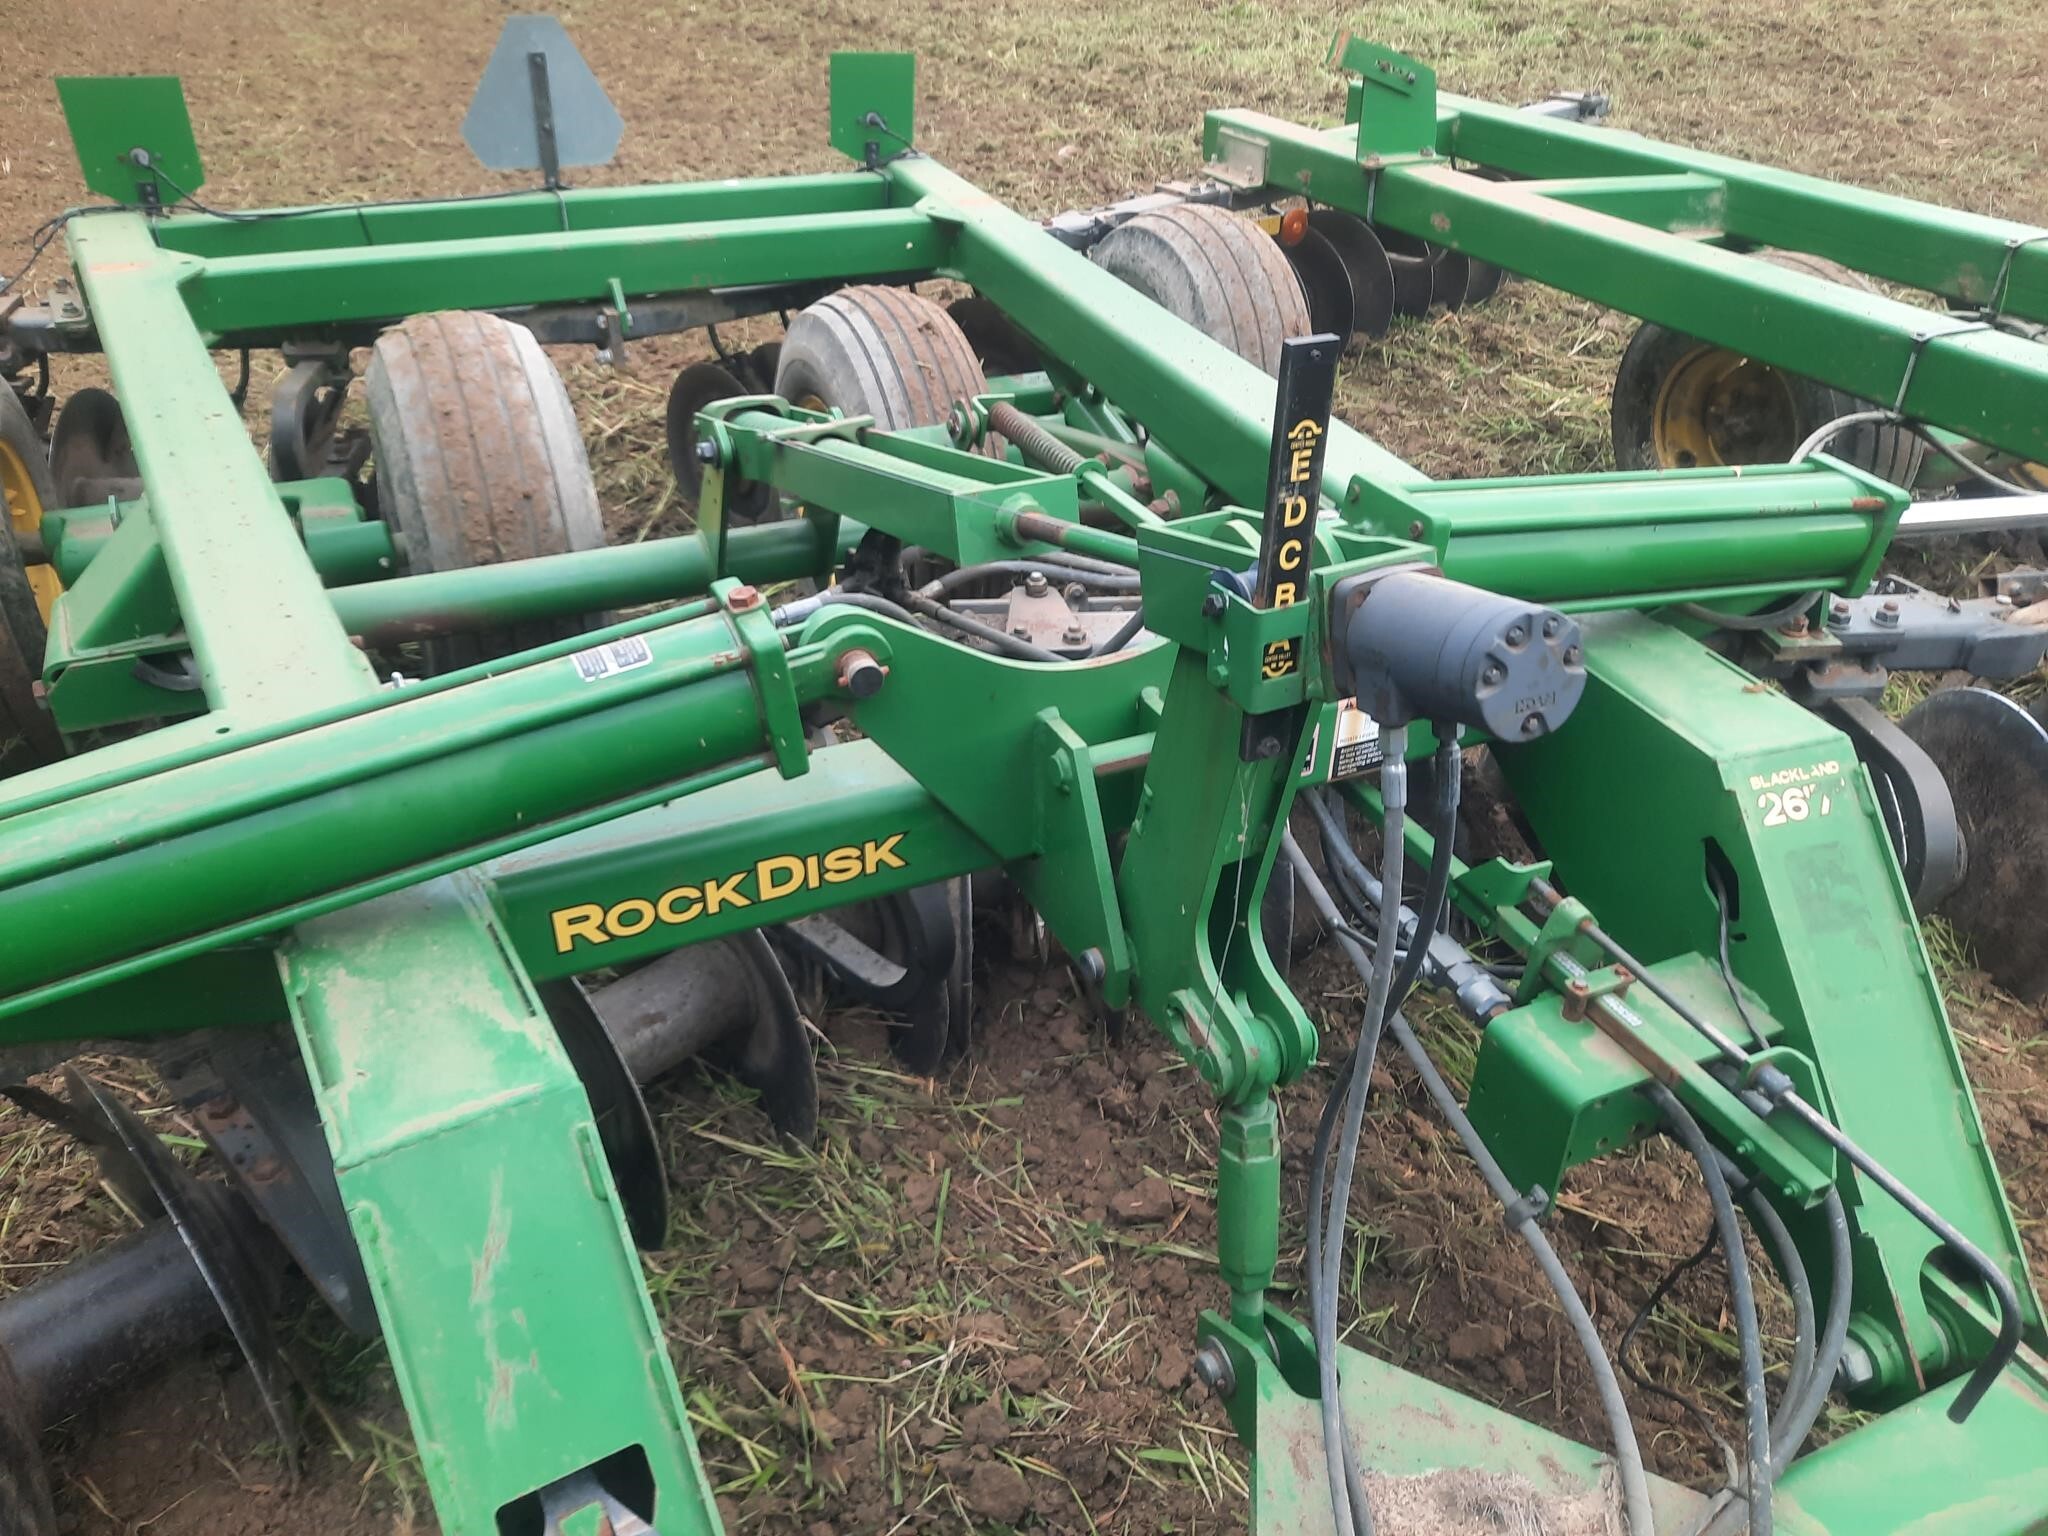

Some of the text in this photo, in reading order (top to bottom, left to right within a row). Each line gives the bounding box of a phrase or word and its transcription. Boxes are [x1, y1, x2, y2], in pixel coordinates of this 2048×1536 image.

[1291, 449, 1313, 483] E
[1284, 496, 1308, 528] D
[1279, 539, 1302, 571] C
[1749, 760, 1839, 790] BLACKLAND
